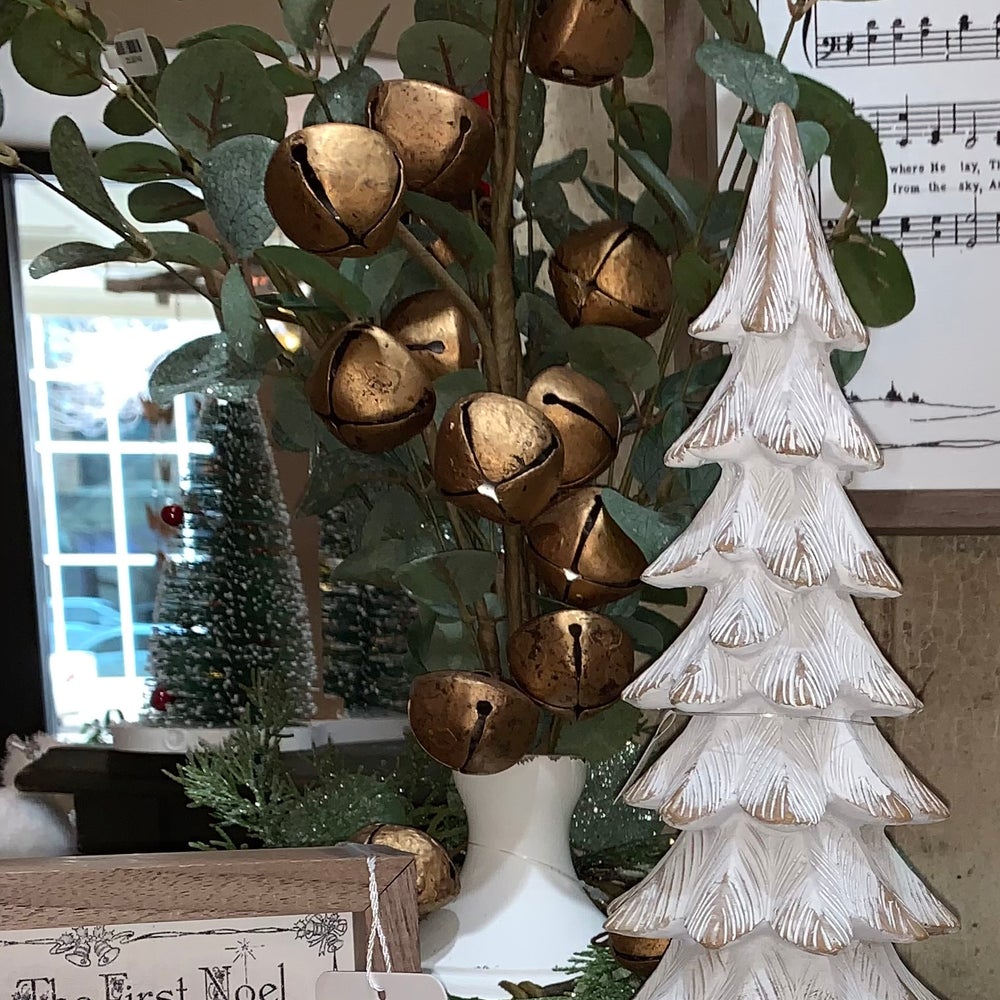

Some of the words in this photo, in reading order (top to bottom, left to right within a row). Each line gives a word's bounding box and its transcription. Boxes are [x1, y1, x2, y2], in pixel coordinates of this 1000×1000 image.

[890, 163, 924, 174] where
[893, 183, 920, 194] from
[929, 182, 946, 192] the
[959, 180, 983, 194] sky,
